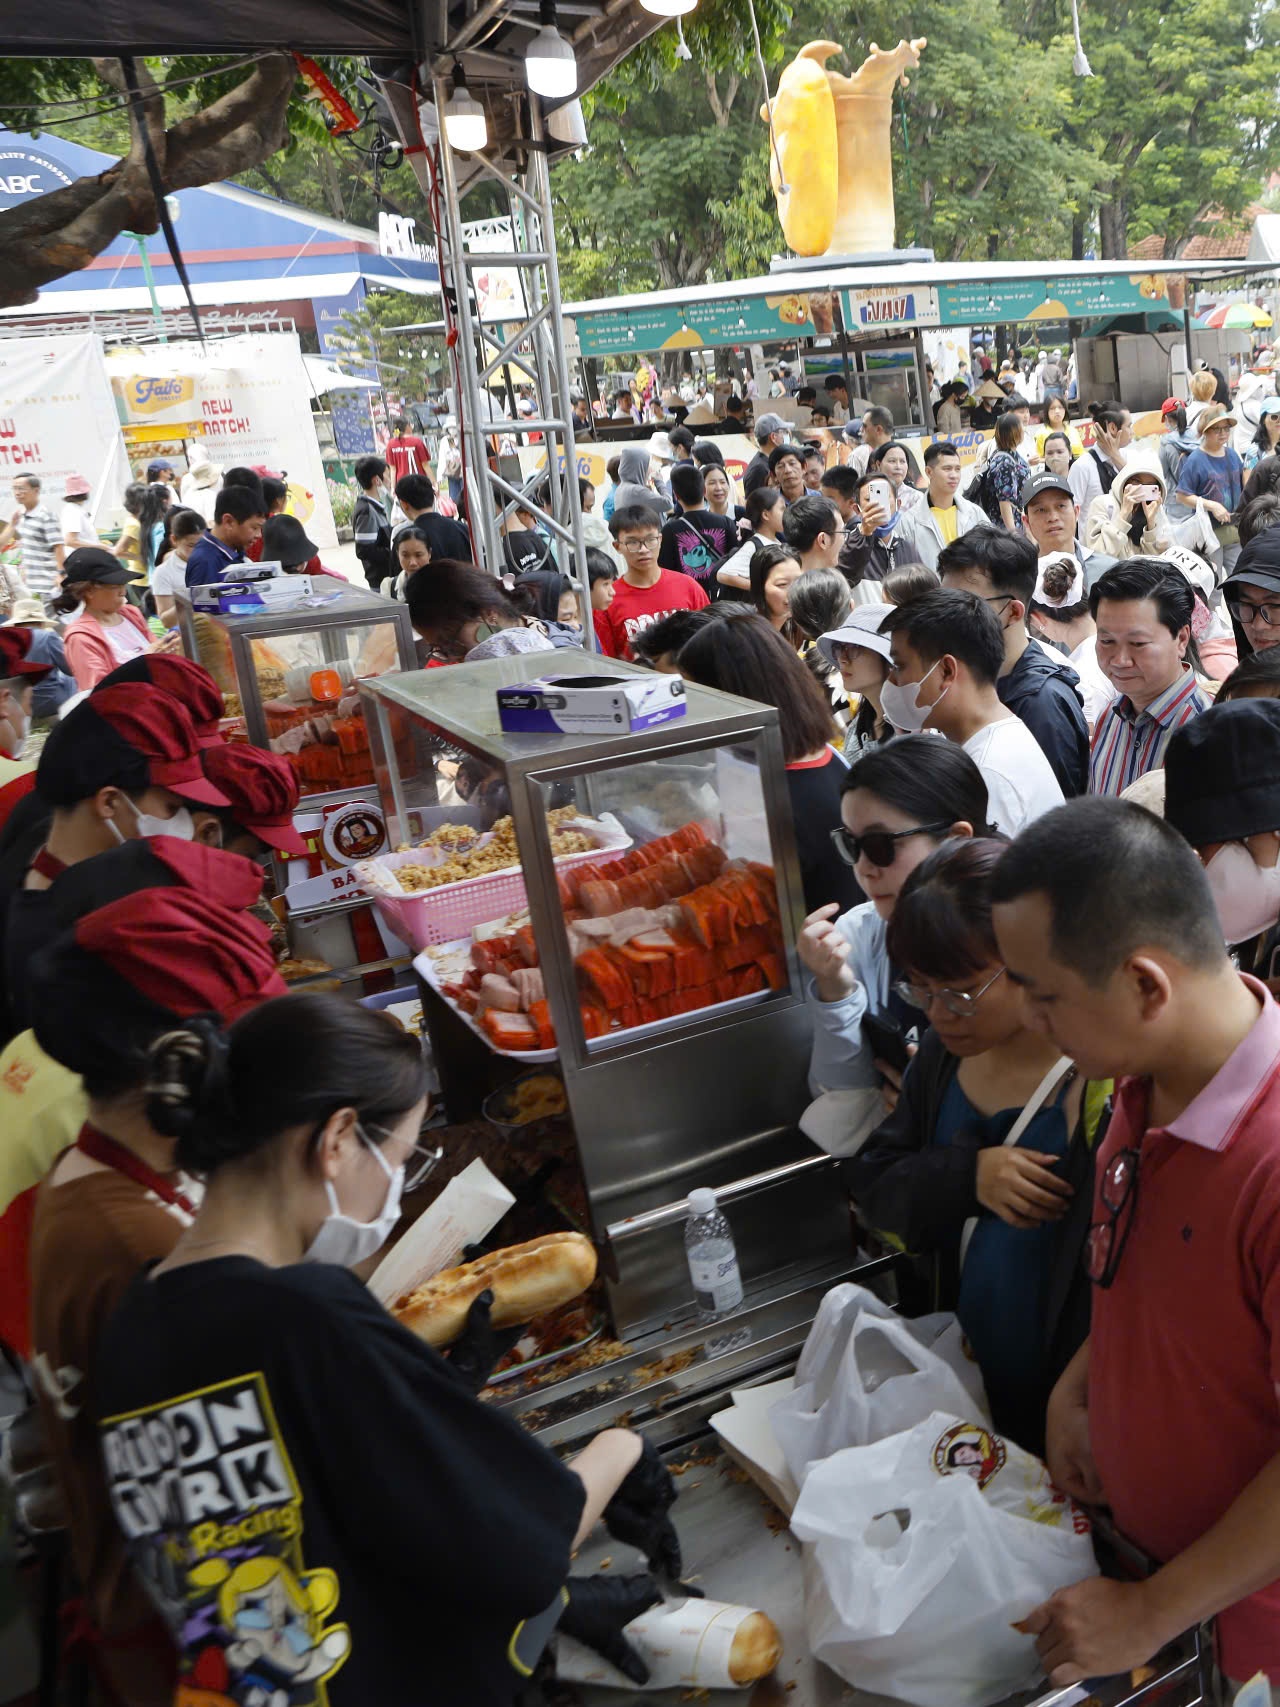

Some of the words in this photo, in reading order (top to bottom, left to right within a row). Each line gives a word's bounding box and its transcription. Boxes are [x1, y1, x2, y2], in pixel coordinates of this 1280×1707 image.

[379, 211, 416, 258] ABC
[136, 377, 182, 404] Faifo
[202, 399, 233, 415] NEW
[188, 1502, 300, 1556] Racing
